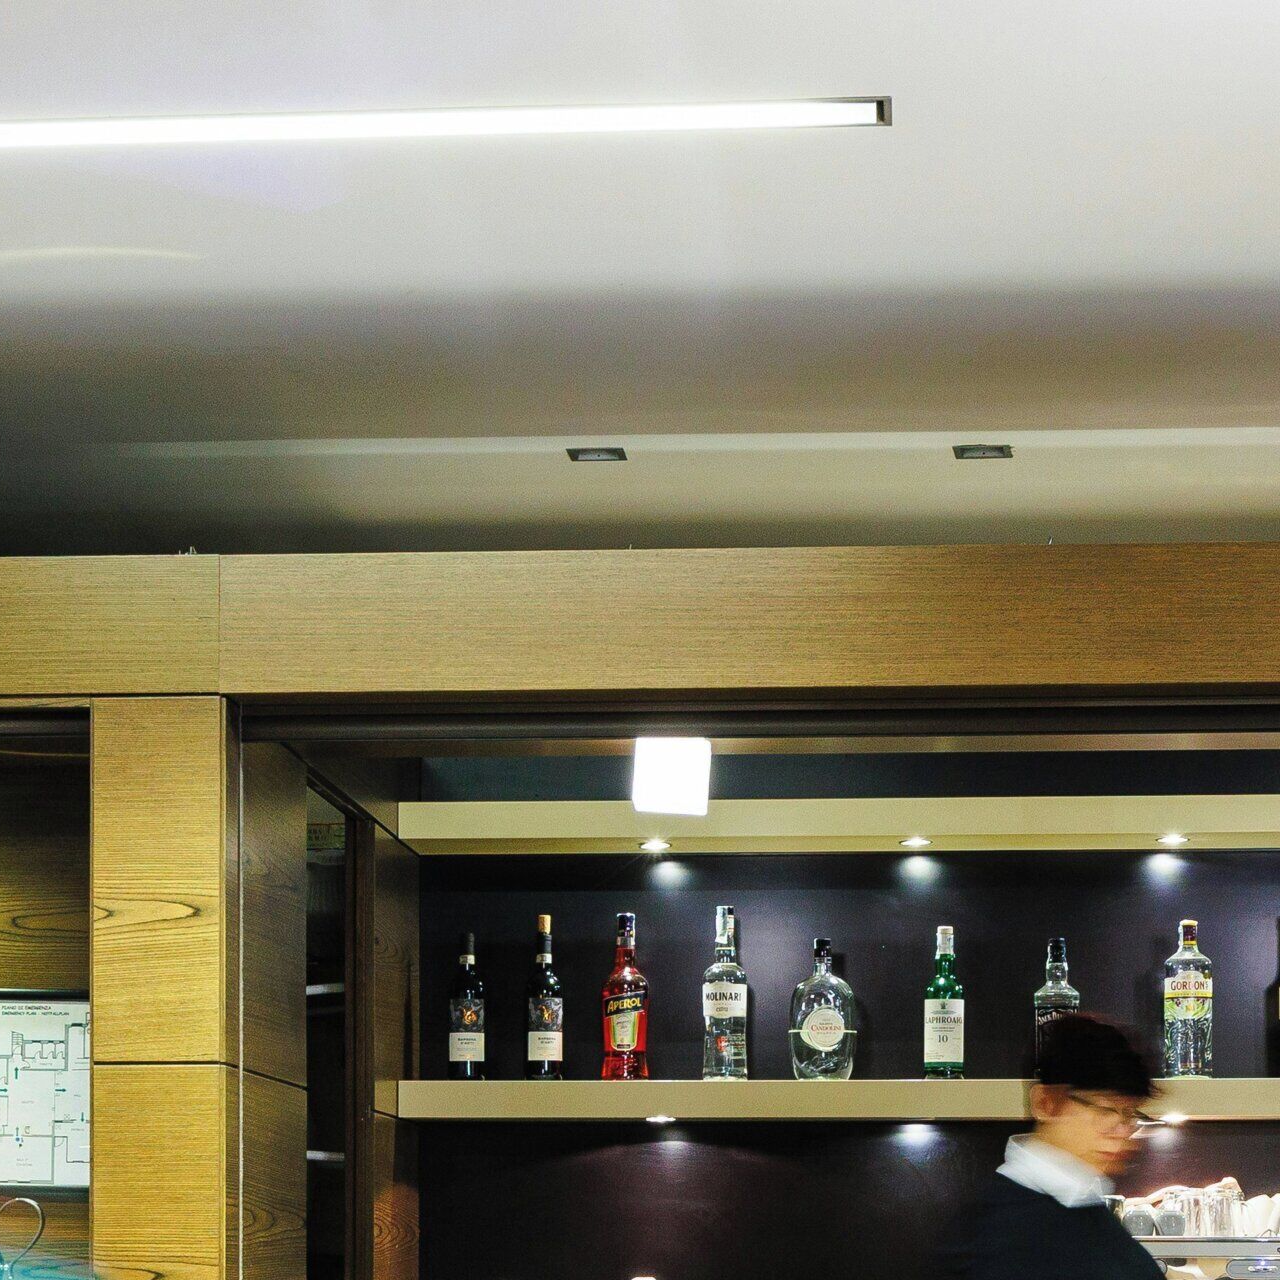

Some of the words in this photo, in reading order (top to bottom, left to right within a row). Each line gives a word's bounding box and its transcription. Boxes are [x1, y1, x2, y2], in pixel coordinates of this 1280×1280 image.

[705, 991, 742, 1002] MOLINARI
[607, 997, 642, 1014] APEROL
[937, 1034, 949, 1043] 10
